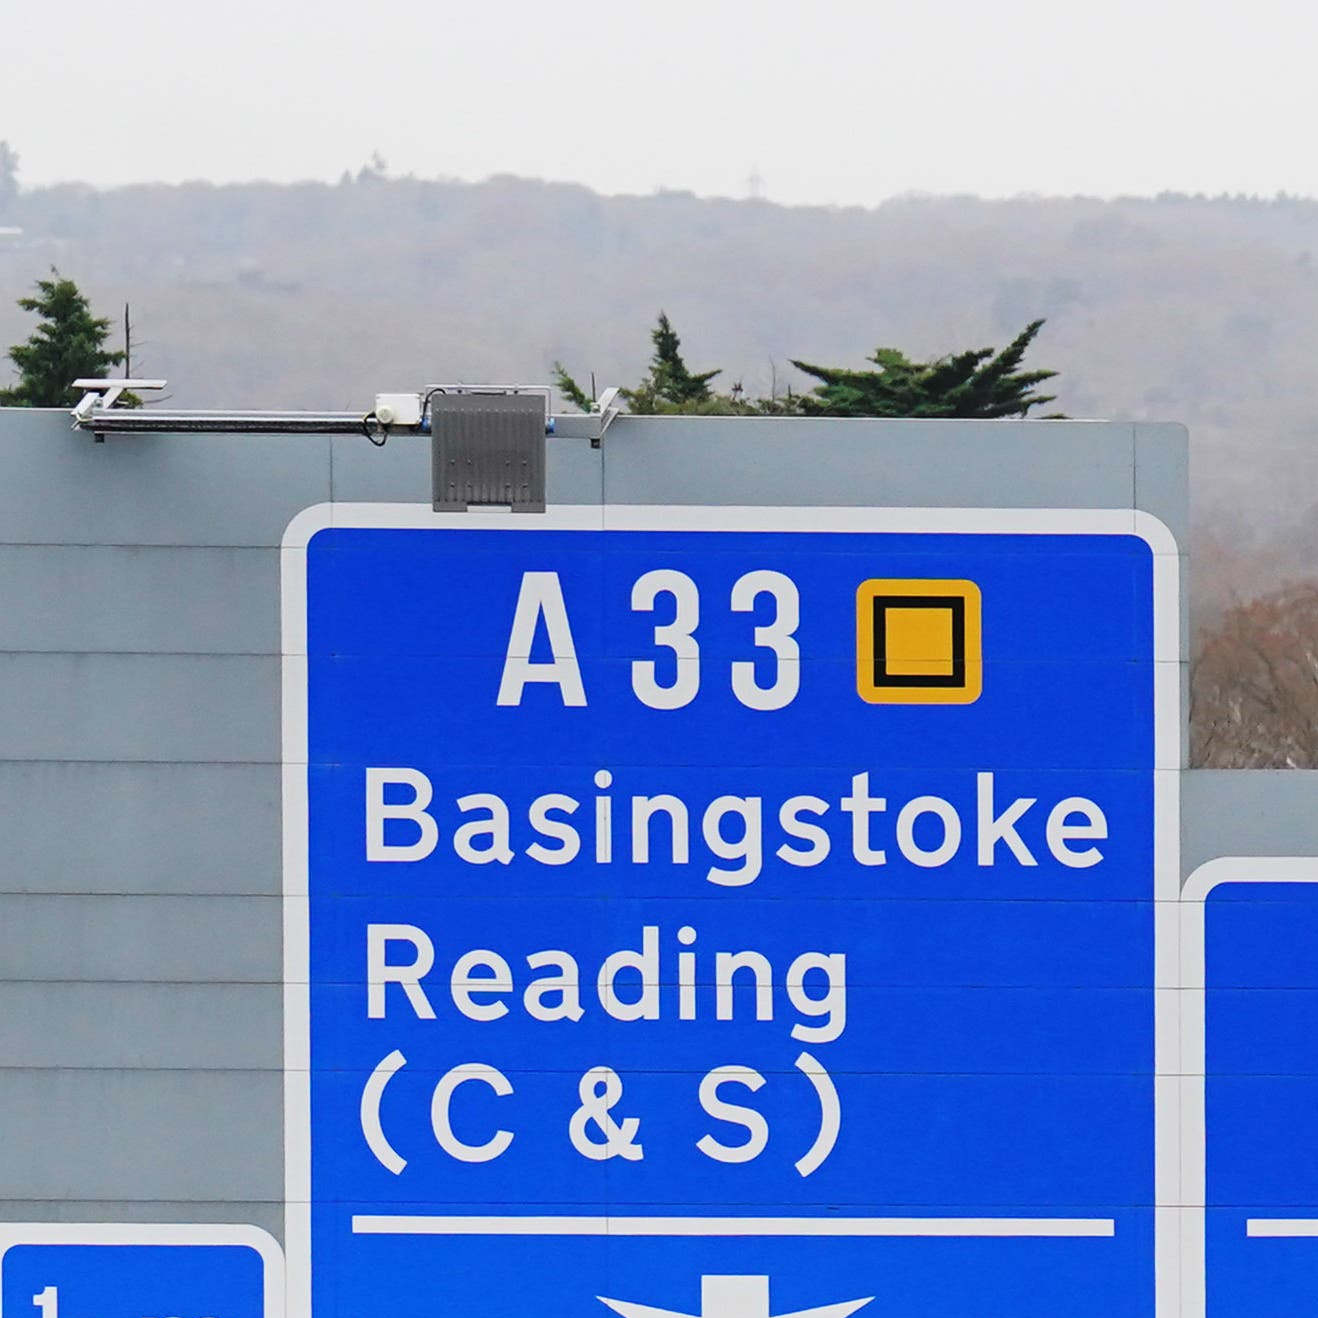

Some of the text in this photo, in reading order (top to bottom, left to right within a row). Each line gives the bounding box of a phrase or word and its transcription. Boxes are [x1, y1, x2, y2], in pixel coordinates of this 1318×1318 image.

[366, 767, 1108, 886] Basingstoke
[367, 923, 846, 1043] Reading
[568, 1066, 644, 1161] &
